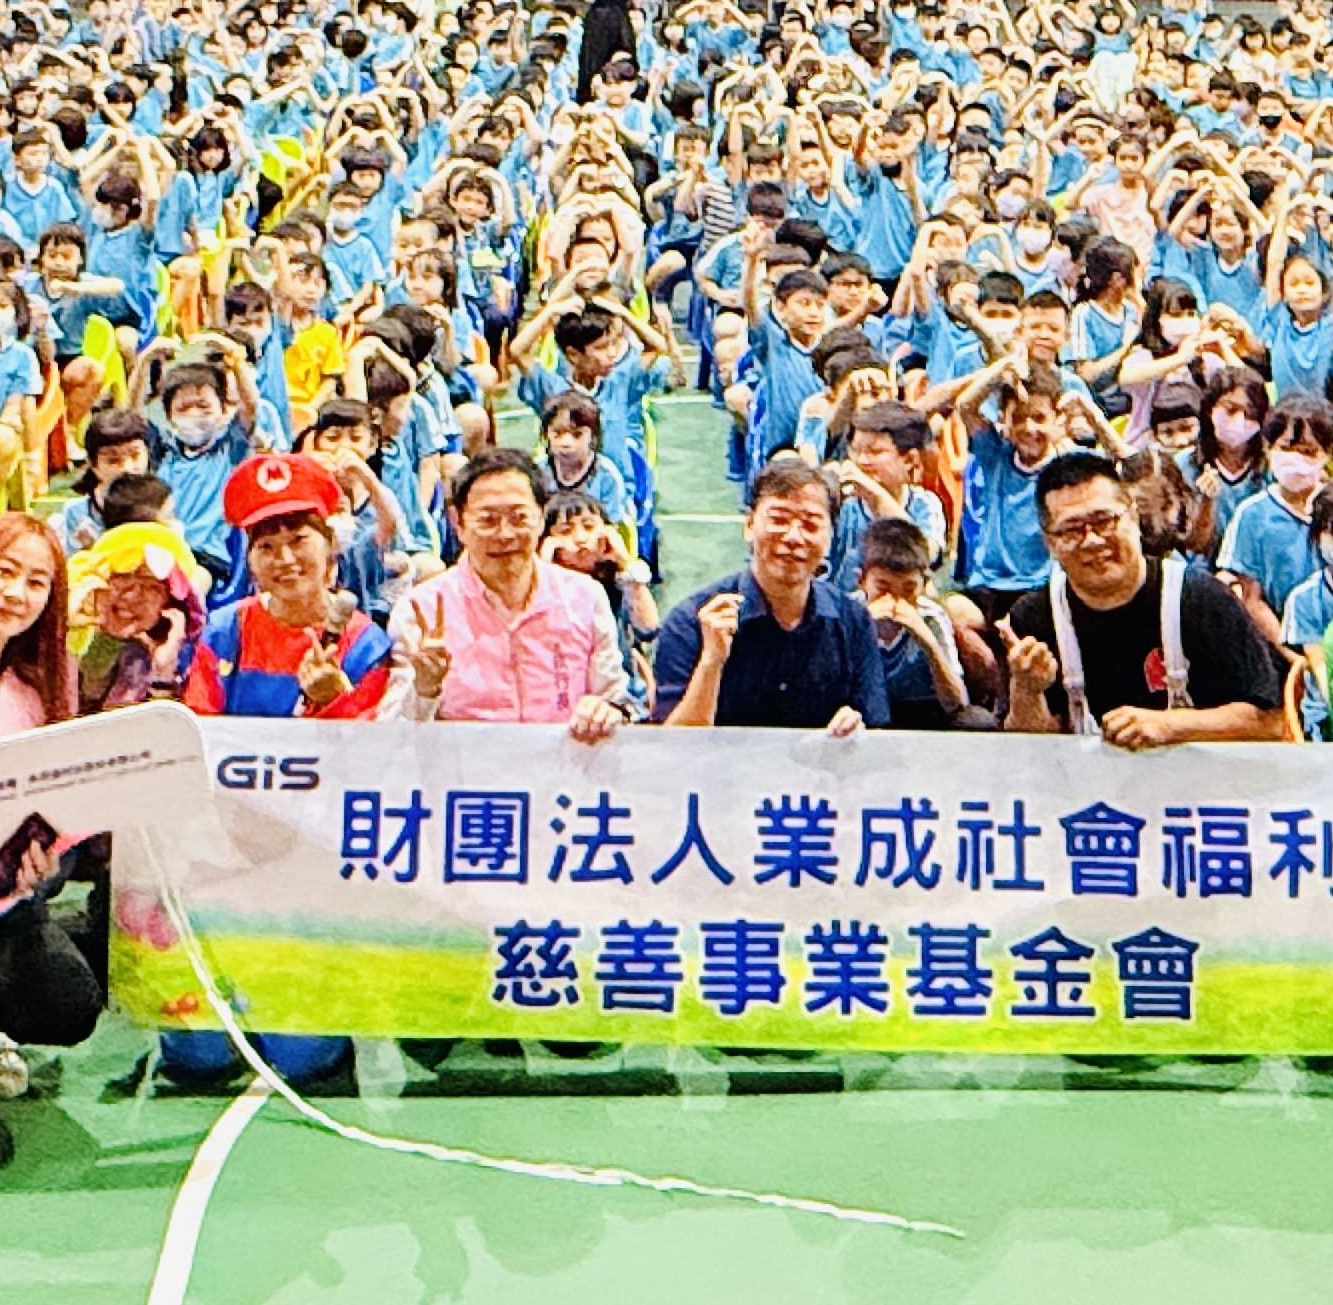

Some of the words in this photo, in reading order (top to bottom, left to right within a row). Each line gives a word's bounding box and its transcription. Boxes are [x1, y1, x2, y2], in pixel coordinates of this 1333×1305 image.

[492, 918, 1200, 1021] 慈善事業基金會
